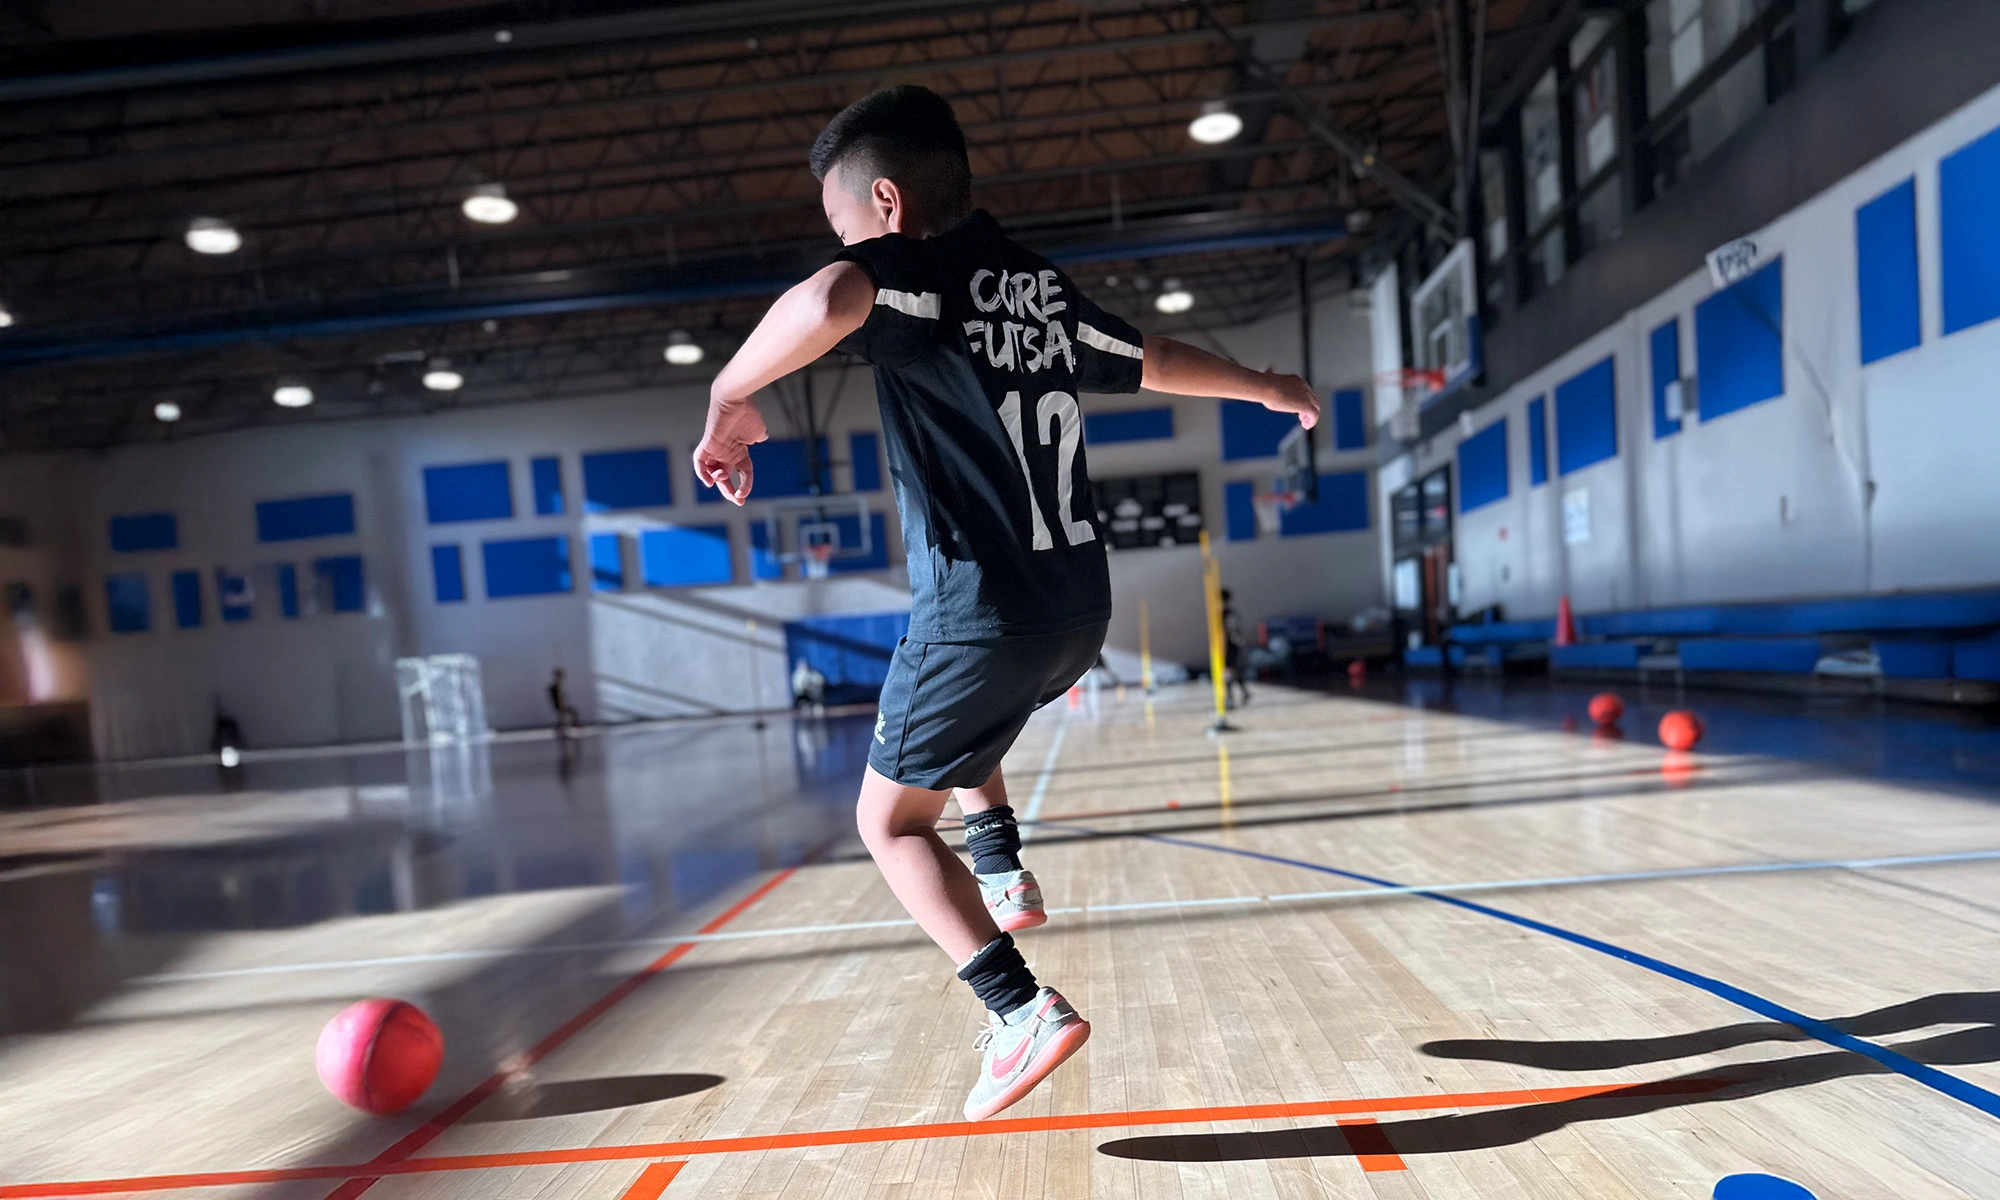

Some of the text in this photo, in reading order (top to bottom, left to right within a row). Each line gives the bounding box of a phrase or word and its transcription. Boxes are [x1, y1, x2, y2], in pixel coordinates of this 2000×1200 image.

[969, 269, 1067, 323] CORE
[962, 320, 1076, 374] FUTSA
[997, 390, 1096, 551] 12
